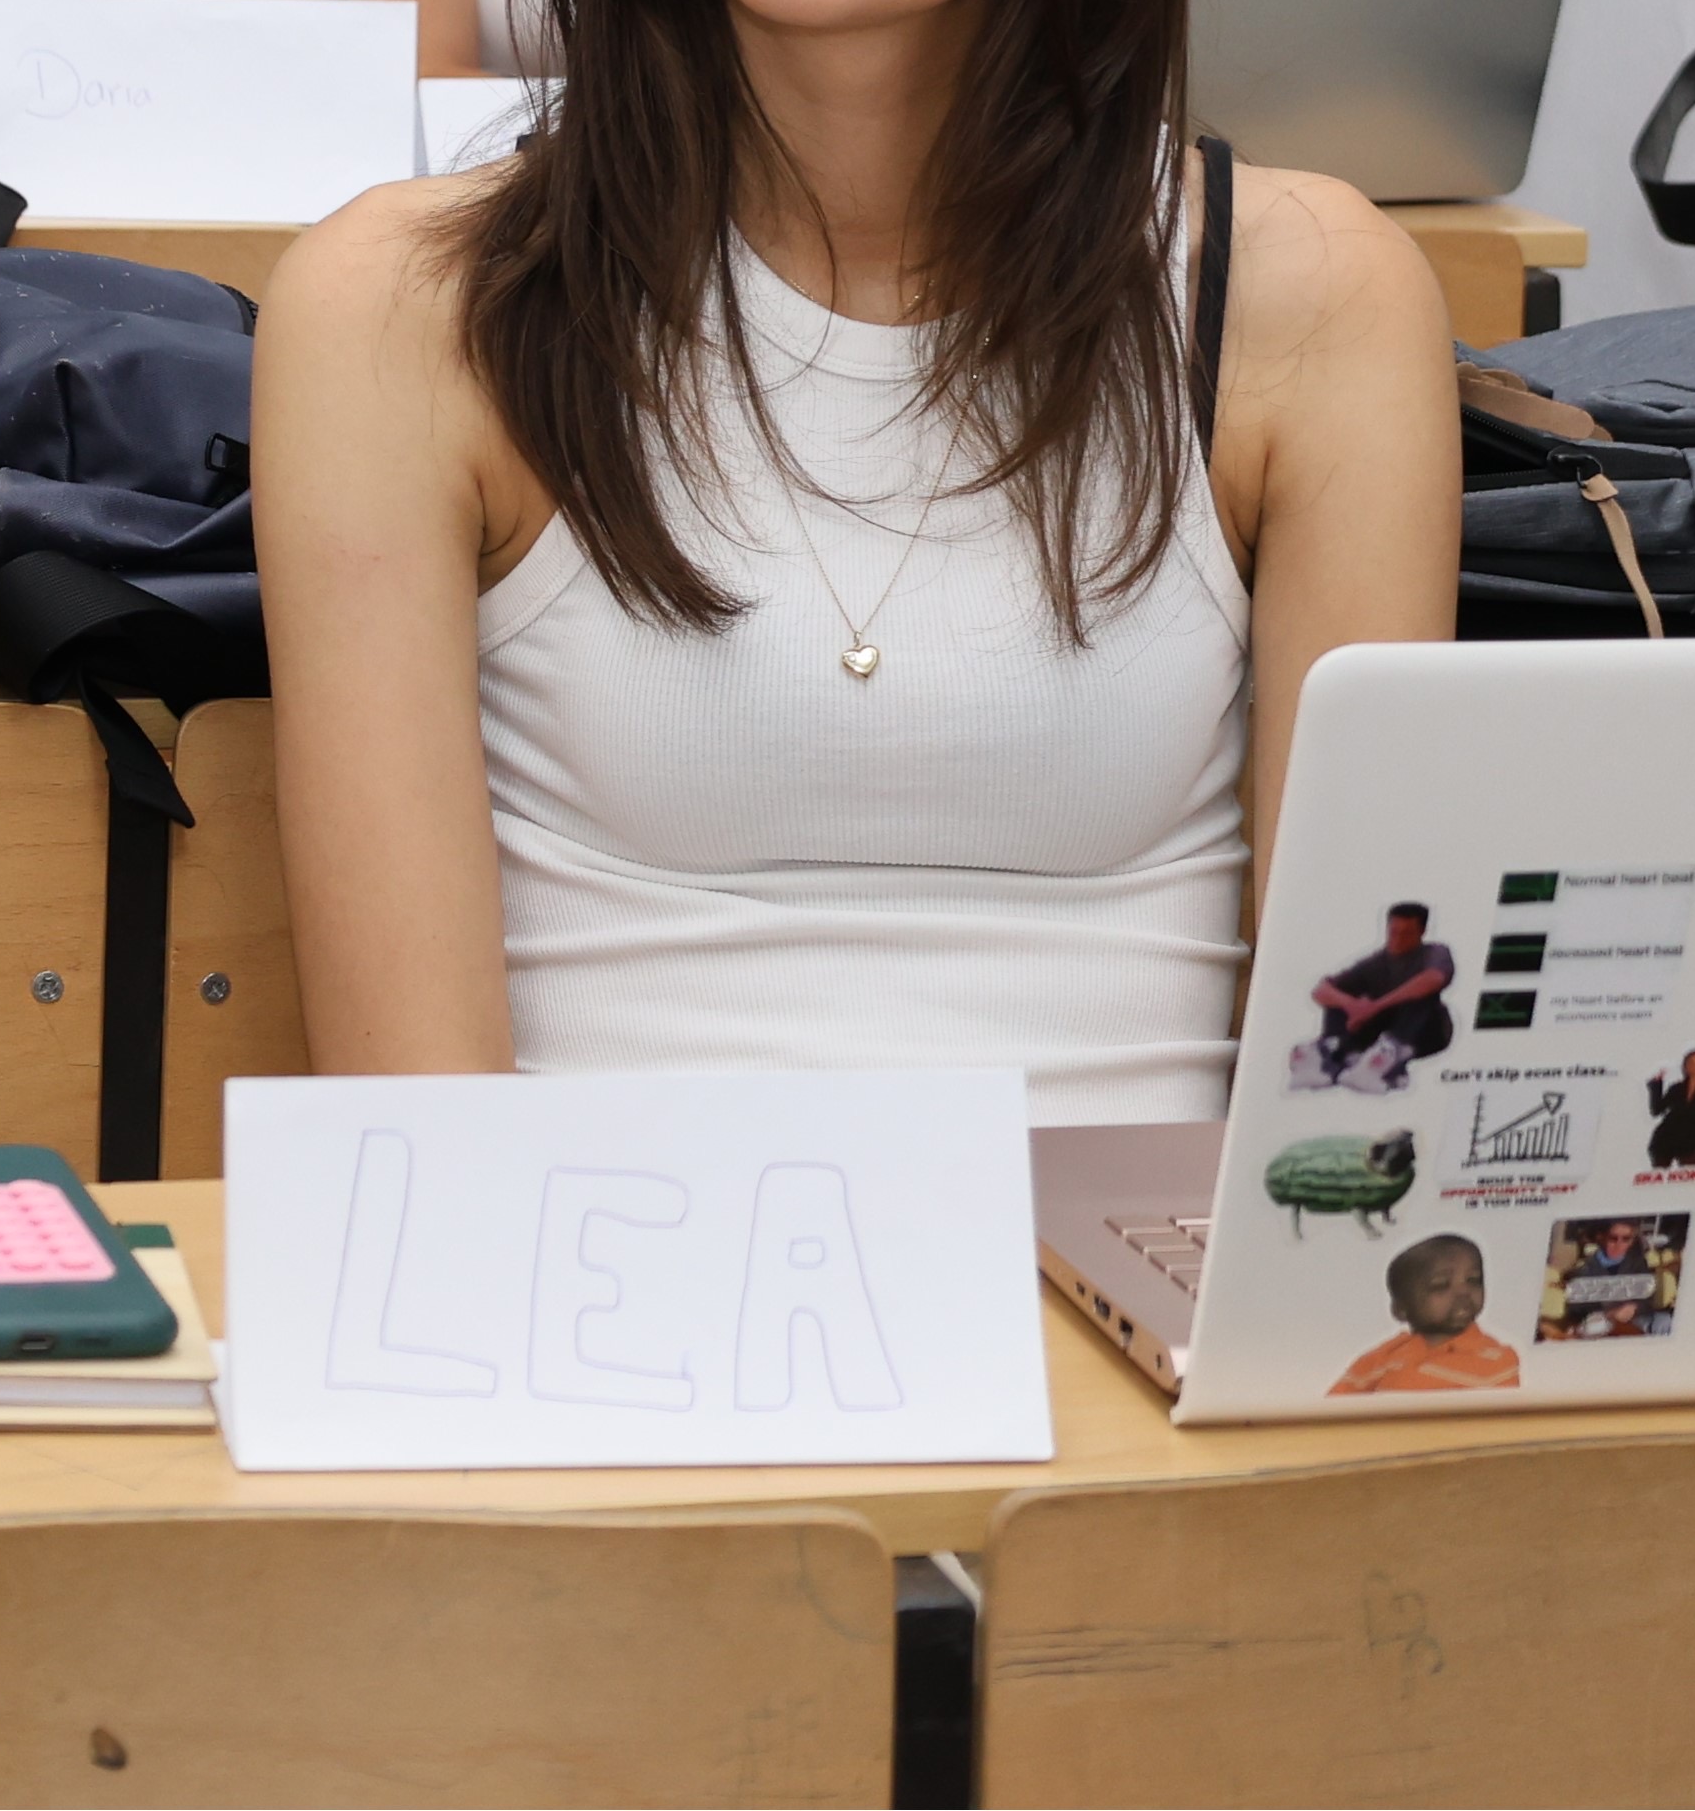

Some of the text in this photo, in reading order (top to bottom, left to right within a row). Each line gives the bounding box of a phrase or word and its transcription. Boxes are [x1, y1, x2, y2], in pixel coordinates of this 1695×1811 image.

[16, 47, 153, 120] Daria
[1440, 1068, 1483, 1083] Can't
[1486, 1067, 1520, 1083] skip
[325, 1128, 905, 1412] LEA
